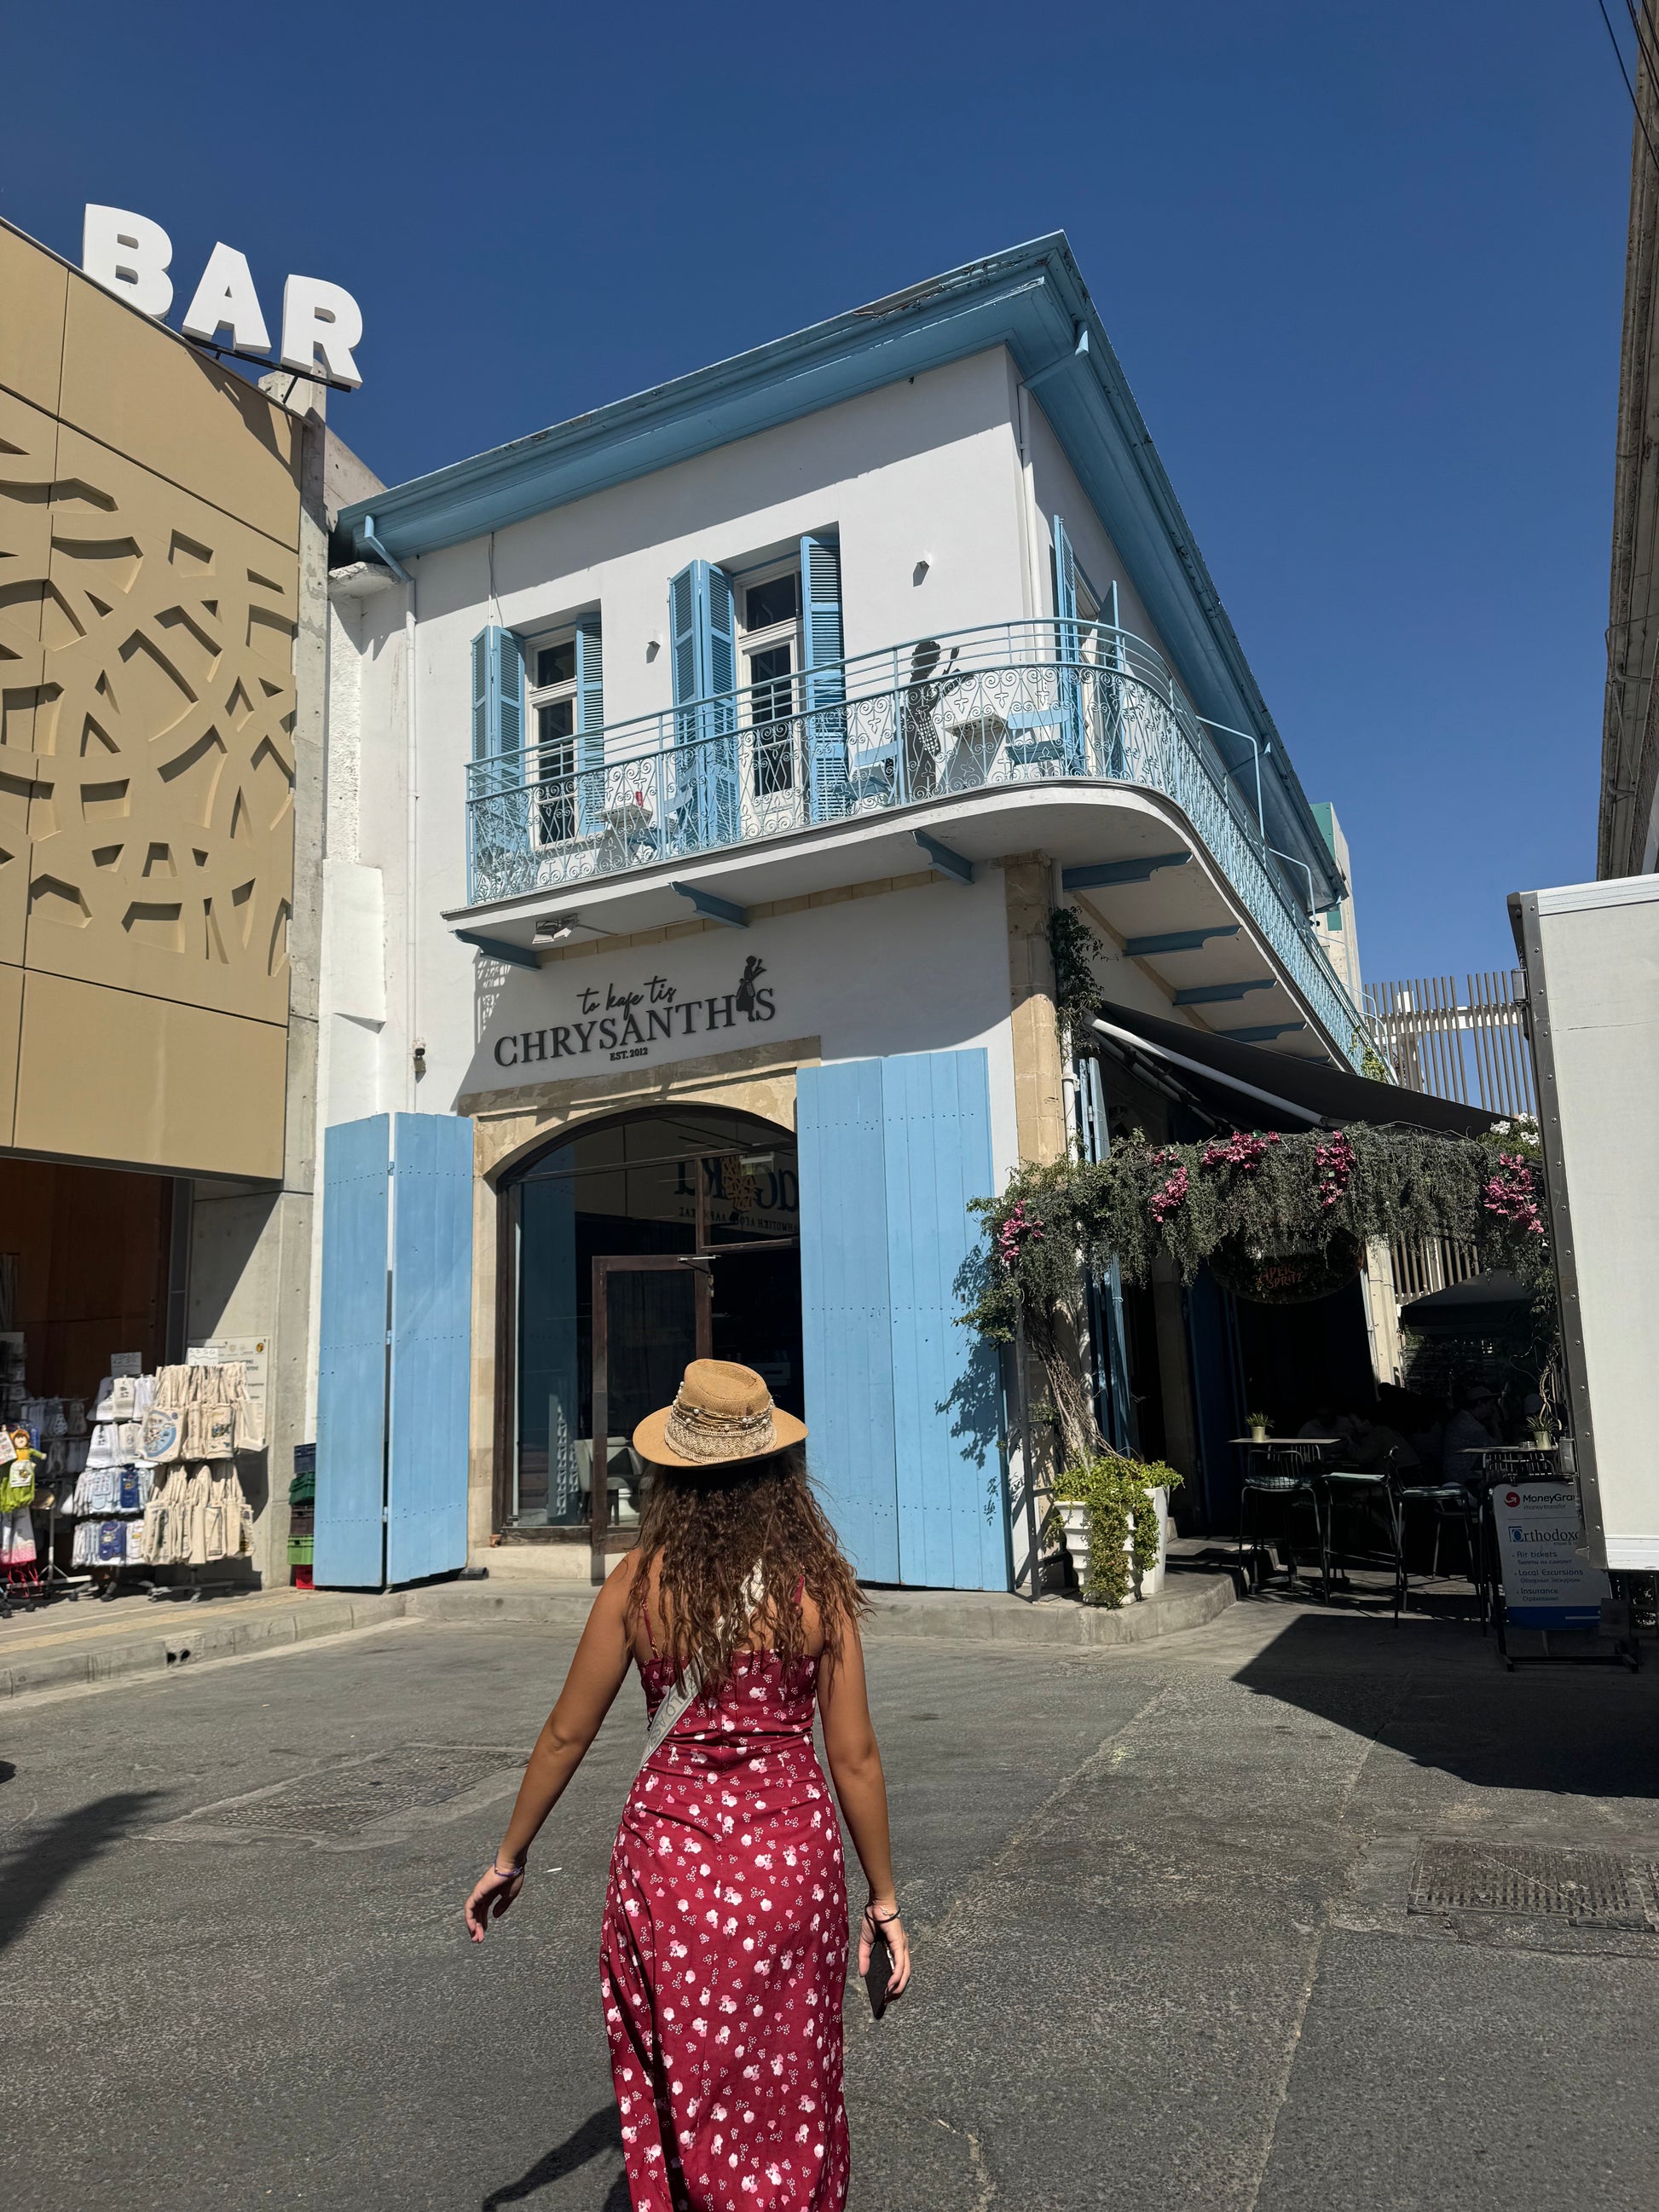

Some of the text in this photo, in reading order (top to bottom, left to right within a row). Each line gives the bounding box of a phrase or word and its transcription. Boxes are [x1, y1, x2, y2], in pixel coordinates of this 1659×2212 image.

[83, 204, 363, 390] BAR
[576, 975, 678, 1021] to kafe tis
[1531, 1550, 1558, 1558] tickets
